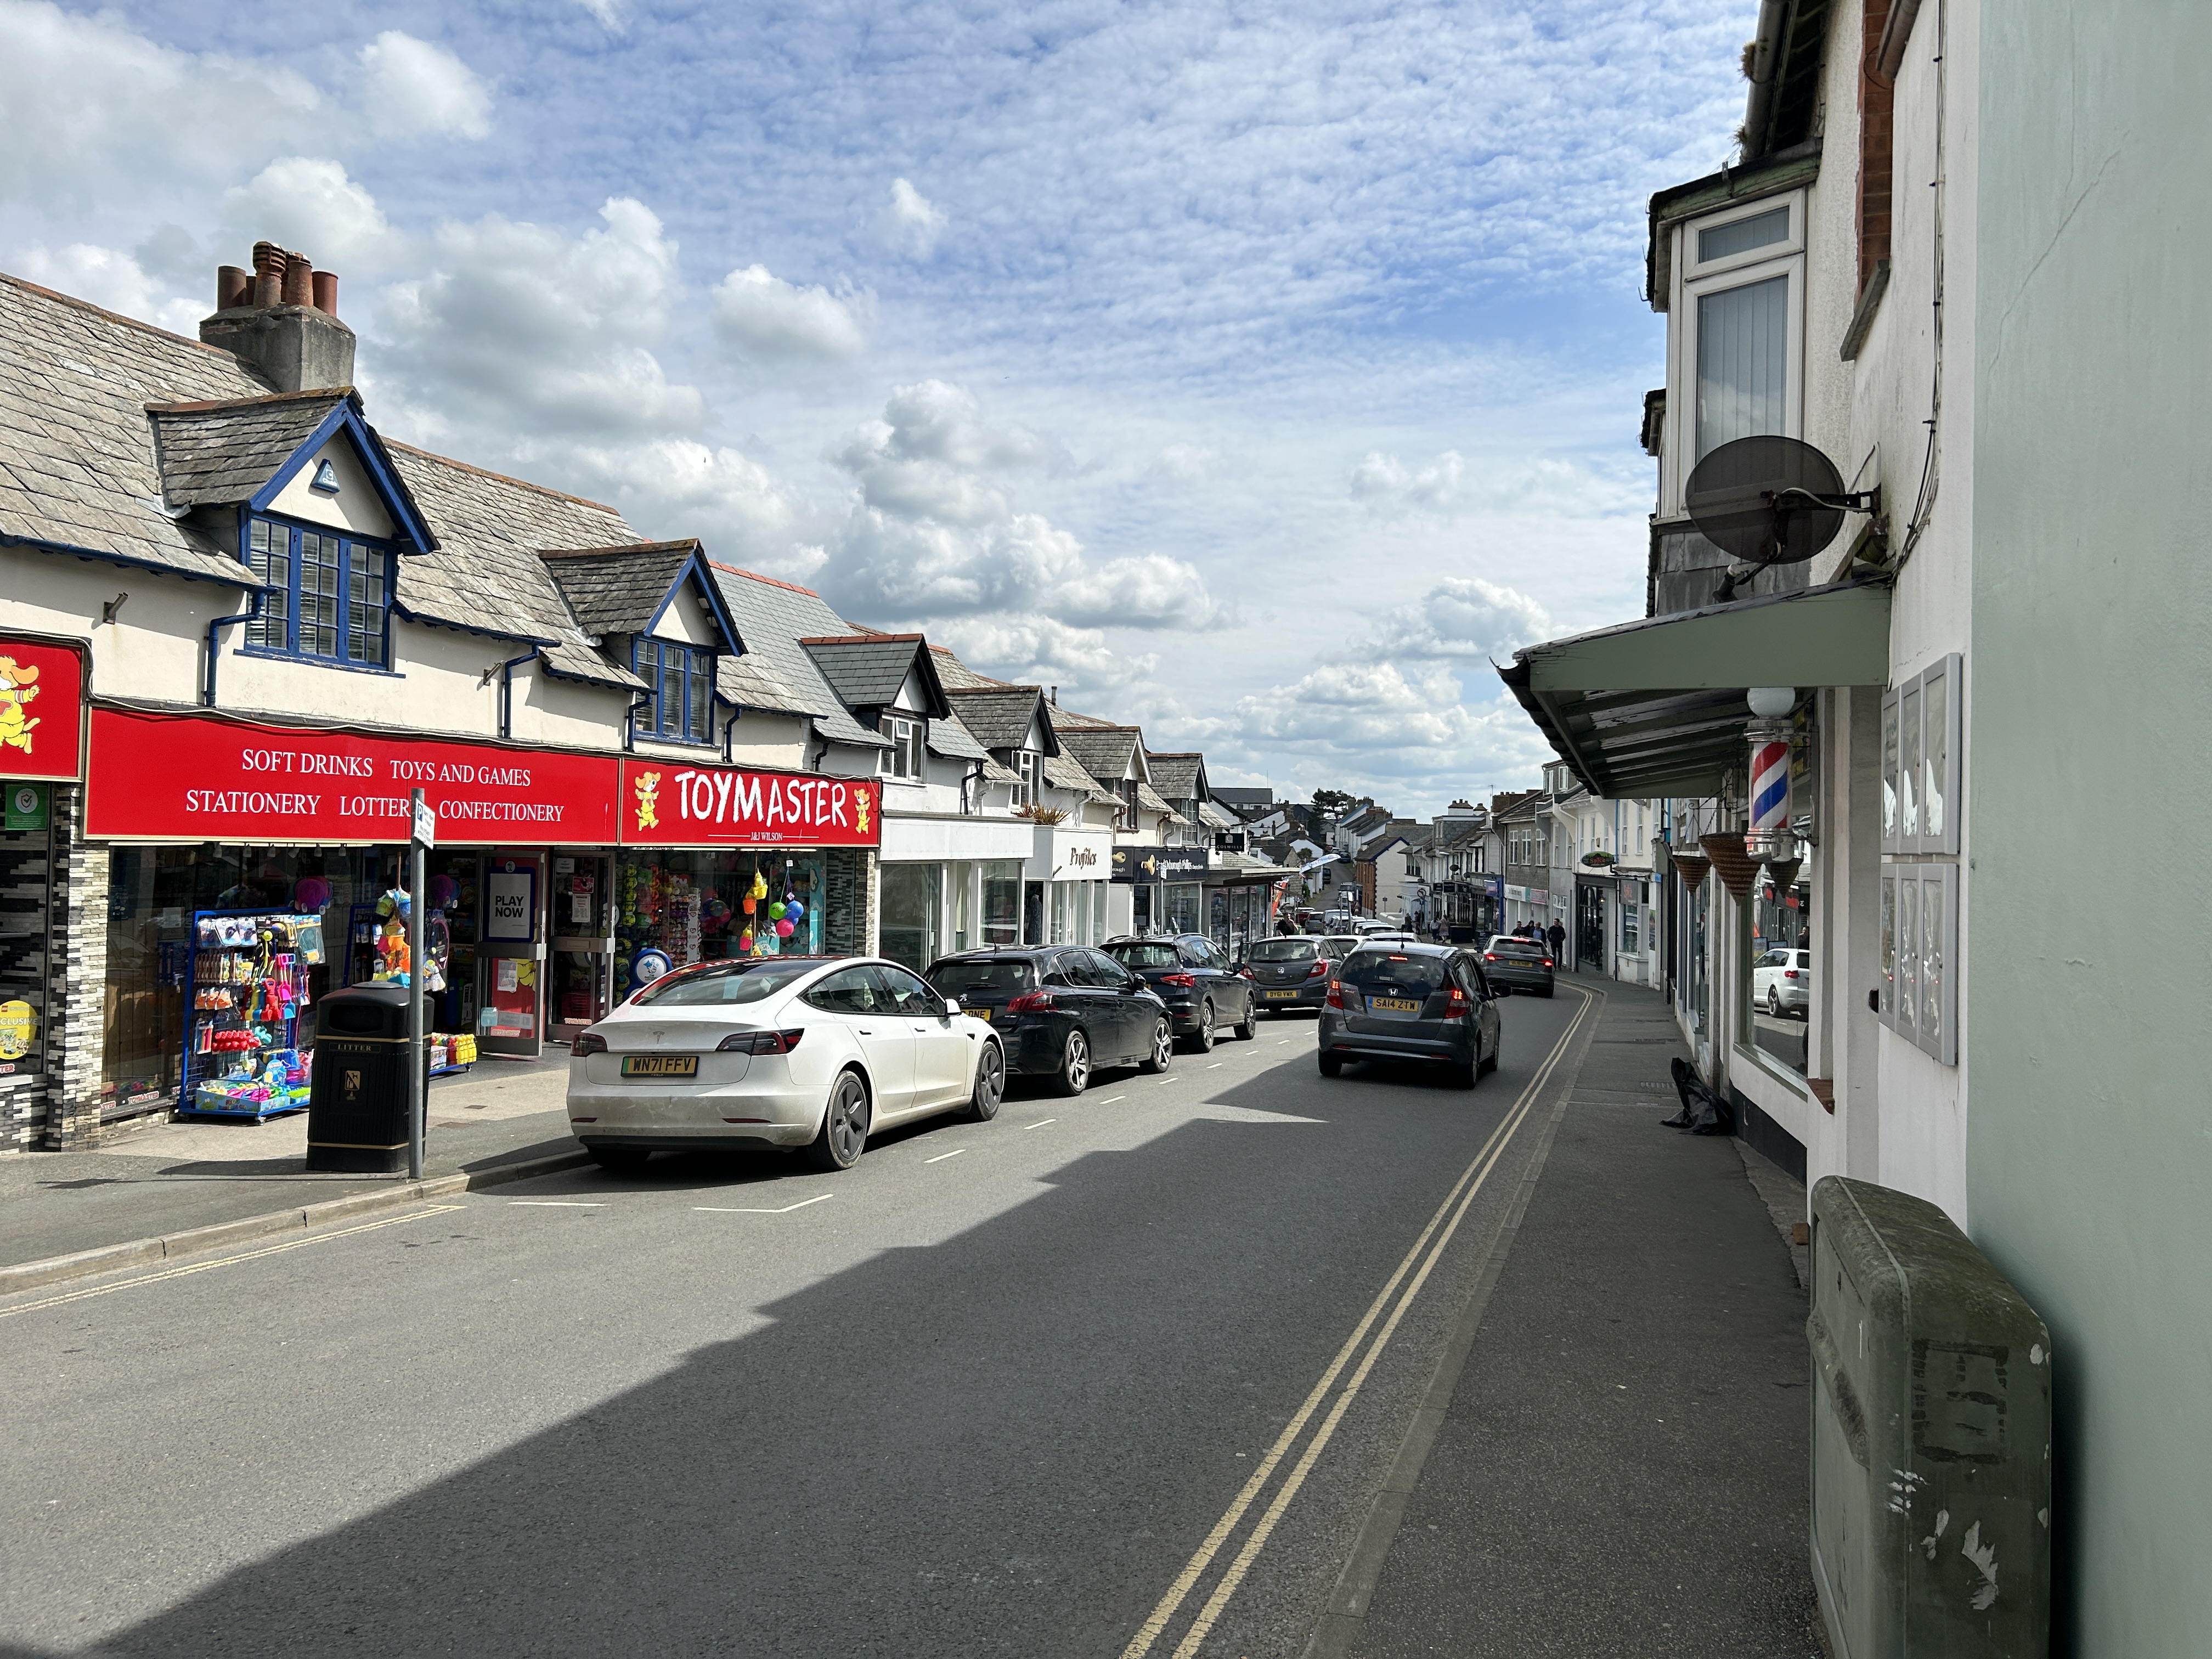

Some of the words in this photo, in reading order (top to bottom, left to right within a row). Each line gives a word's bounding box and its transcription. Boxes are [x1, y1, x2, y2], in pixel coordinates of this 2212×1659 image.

[242, 749, 296, 772] SOFT
[300, 753, 373, 777] DRINKS
[390, 760, 436, 781] TOYS
[439, 764, 474, 783] AND
[478, 766, 531, 786] GAMES
[674, 770, 848, 827] TOYMASTER
[187, 789, 321, 815] STATIONERY
[340, 796, 411, 817] LOTTER
[439, 800, 565, 822] CONFECTIONERY
[751, 831, 760, 841] J&J
[761, 832, 783, 841] WILSON
[495, 895, 524, 906] PLAY
[495, 906, 524, 918] NOW
[1376, 998, 1396, 1008] SA14
[0, 1017, 38, 1026] CLUSIVE
[633, 1058, 663, 1071] WN71
[665, 1057, 691, 1071] FFV
